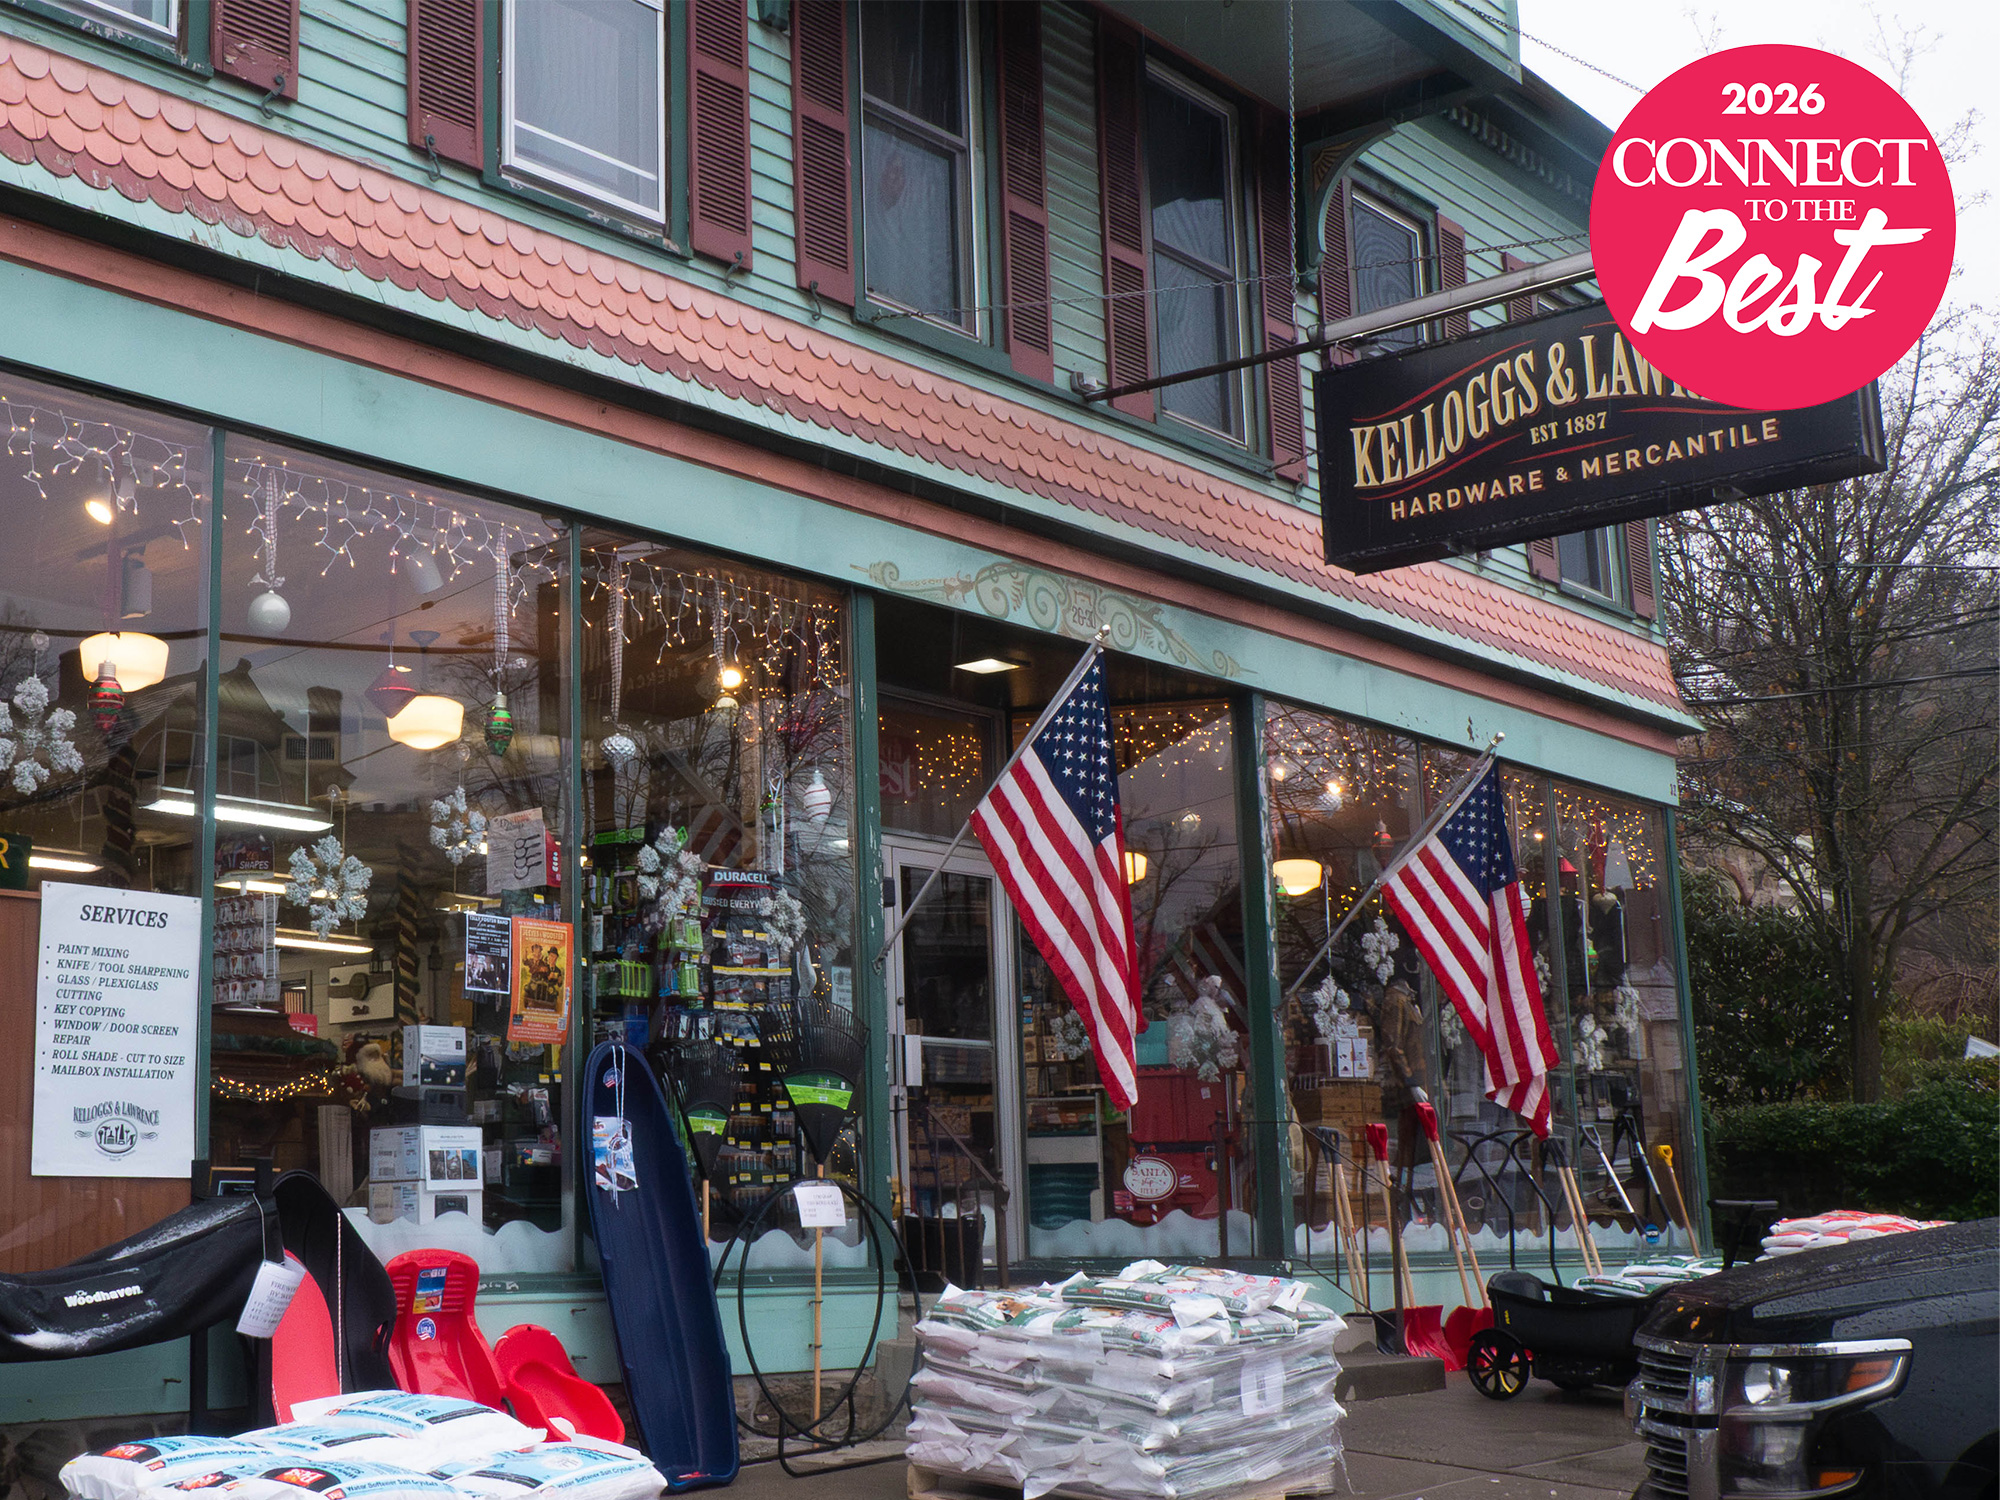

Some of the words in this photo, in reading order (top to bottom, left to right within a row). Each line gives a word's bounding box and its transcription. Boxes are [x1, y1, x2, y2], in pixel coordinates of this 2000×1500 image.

[1350, 349, 1539, 488] KELLOGGS
[1546, 341, 1578, 406] &
[1530, 421, 1558, 445] EST
[1565, 411, 1607, 438] 1887
[1390, 469, 1544, 520] HARDWARE
[1556, 466, 1569, 481] &
[1581, 418, 1780, 478] MERCANTILE
[714, 871, 770, 884] DURACELL
[80, 905, 168, 929] SERVICES
[57, 943, 90, 955] PAINT
[91, 947, 130, 959] MIXING
[57, 959, 90, 971] KNIFE
[98, 962, 125, 974] TOOL
[128, 965, 190, 979] SHARPENING
[57, 974, 91, 986] GLASS
[98, 977, 159, 991] PLEXIGLASS
[56, 989, 103, 1001] CUTTING
[54, 1004, 77, 1015] KEY
[79, 1006, 126, 1018] COPYING
[54, 1019, 102, 1031] WINDOW
[109, 1023, 140, 1034] DOOR
[141, 1025, 179, 1037] SCREEN
[53, 1034, 91, 1045] REPAIR
[52, 1049, 79, 1060] ROLL
[81, 1051, 119, 1062] SHADE
[126, 1053, 146, 1063] CUT
[148, 1054, 161, 1064] TO
[163, 1055, 186, 1066] SIZE
[51, 1065, 101, 1077] MAILBOX
[103, 1067, 175, 1080] INSTALLATION
[73, 1101, 113, 1123] KELLOGGS
[121, 1101, 160, 1126] LAWRENCE
[346, 1483, 367, 1492] Water
[367, 1480, 397, 1489] Softener
[398, 1478, 412, 1486] Salt
